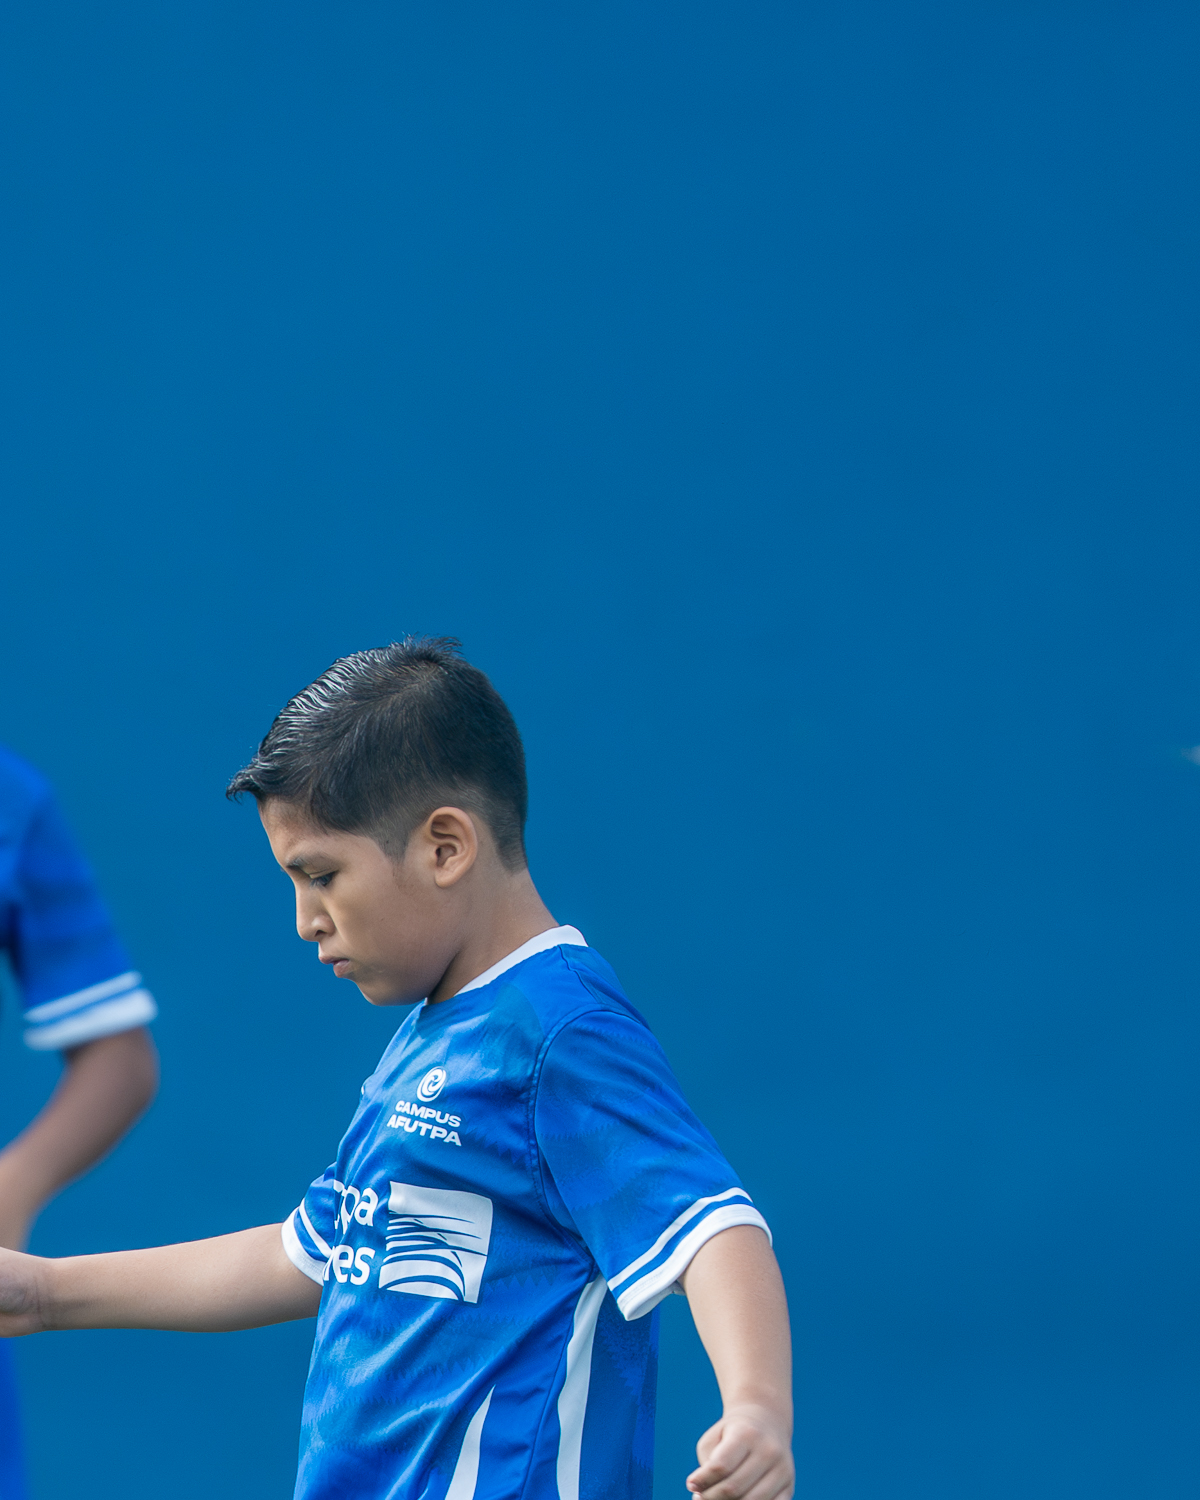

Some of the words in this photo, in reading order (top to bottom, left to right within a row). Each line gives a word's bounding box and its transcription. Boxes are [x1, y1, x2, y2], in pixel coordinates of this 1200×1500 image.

[386, 1114, 462, 1147] AFUTPA
[395, 1100, 462, 1127] CAMPUS
[333, 1179, 379, 1235] pa
[323, 1245, 376, 1286] es
